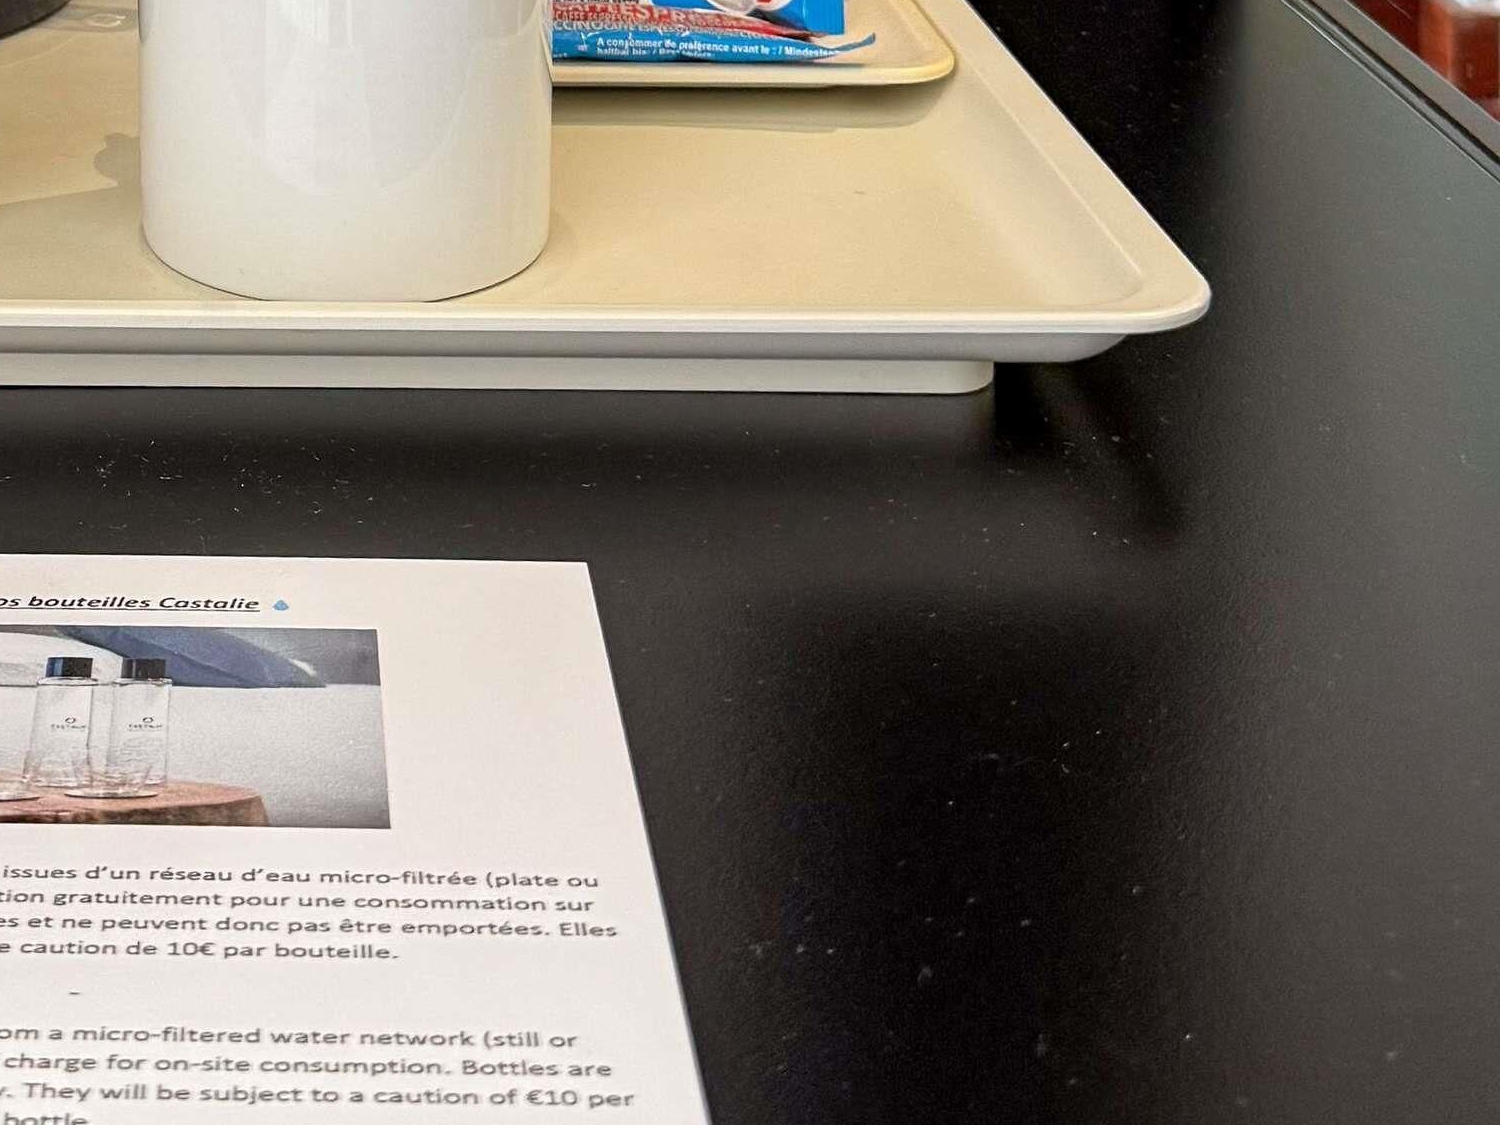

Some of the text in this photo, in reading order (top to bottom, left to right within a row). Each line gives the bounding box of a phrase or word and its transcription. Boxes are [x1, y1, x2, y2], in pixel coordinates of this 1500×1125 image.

[731, 44, 759, 54] avant
[760, 44, 770, 55] le
[27, 595, 151, 609] bouteilles
[158, 596, 260, 610] Castalie
[2, 865, 78, 880] issues
[84, 864, 141, 881] d’un
[149, 865, 233, 882] réseau
[241, 867, 311, 883] d’eau
[319, 868, 477, 886] micro-filtrée
[485, 871, 559, 890] (plate
[567, 876, 599, 888] ou
[52, 889, 223, 909] gratuitement
[230, 895, 291, 910] pour
[298, 896, 346, 909] une
[353, 894, 547, 912] consommation
[554, 900, 594, 913] sur
[27, 915, 54, 930] et
[61, 918, 93, 929] ne
[100, 916, 208, 934] peuvent
[215, 916, 280, 933] donc
[287, 921, 331, 935] pas
[339, 918, 392, 934] être
[401, 920, 550, 939] emportées.
[558, 922, 618, 938] Elles
[19, 939, 117, 956] caution
[125, 940, 158, 957] de
[167, 941, 215, 957] 10€
[223, 945, 267, 961] par
[274, 942, 399, 960] bouteille.
[48, 1029, 63, 1041] a
[72, 1025, 261, 1044] micro-filtered
[270, 1030, 351, 1046] water
[360, 1029, 475, 1047] network
[483, 1029, 540, 1050] (still
[548, 1035, 578, 1049] or
[3, 1052, 98, 1074] charge
[106, 1053, 148, 1072] for
[154, 1055, 251, 1073] on-site
[259, 1056, 452, 1078] consumption.
[461, 1058, 560, 1077] Bottles
[567, 1064, 612, 1078] are
[23, 1082, 91, 1103] They
[100, 1083, 147, 1100] will
[155, 1084, 191, 1102] be
[199, 1085, 303, 1106] subject
[310, 1088, 340, 1103] to
[348, 1091, 364, 1103] a
[373, 1087, 479, 1106] caution
[489, 1088, 518, 1105] of
[525, 1088, 579, 1106] €10
[588, 1093, 635, 1111] per
